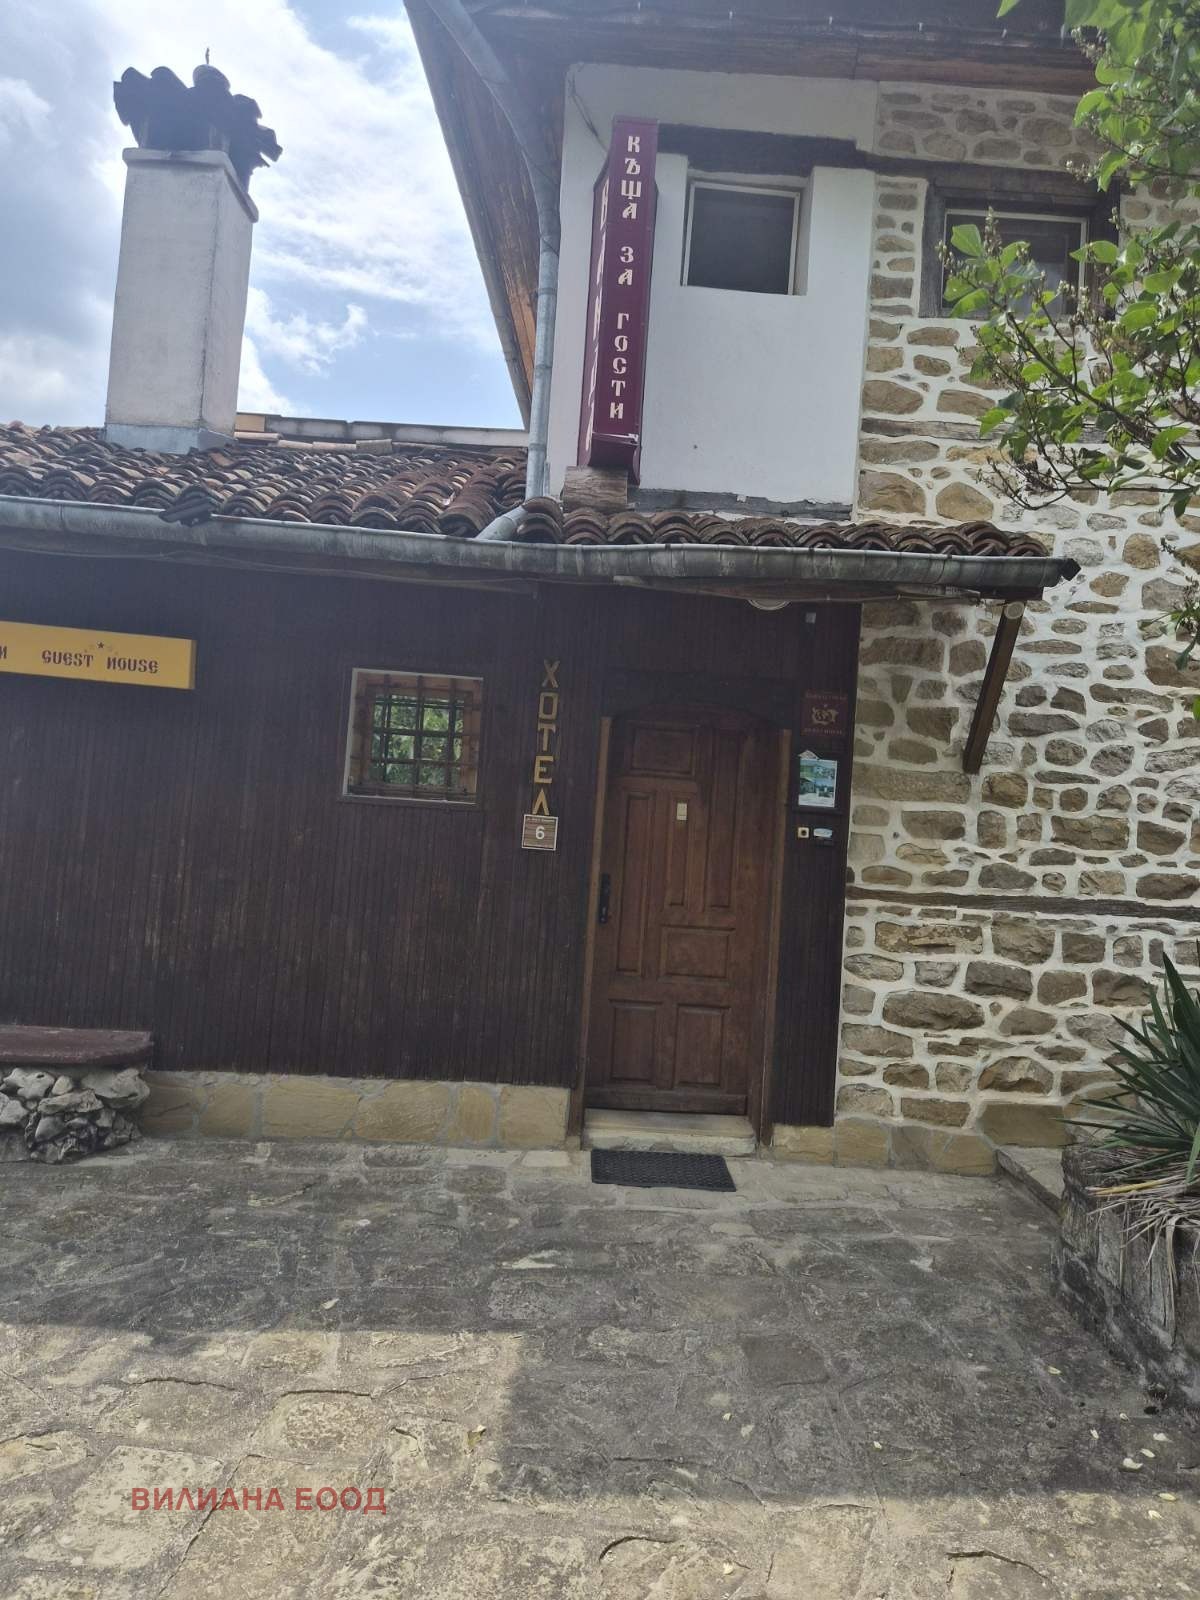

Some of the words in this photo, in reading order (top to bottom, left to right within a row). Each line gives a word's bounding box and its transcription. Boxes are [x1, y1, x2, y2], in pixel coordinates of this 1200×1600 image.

[620, 135, 642, 220] КЪЩА
[618, 246, 634, 286] ЗА
[610, 312, 630, 419] ГОСТИ
[41, 649, 94, 668] GUEST
[106, 656, 159, 674] HOUSE
[532, 659, 560, 815] ХОТЕЛ
[535, 825, 546, 840] 6
